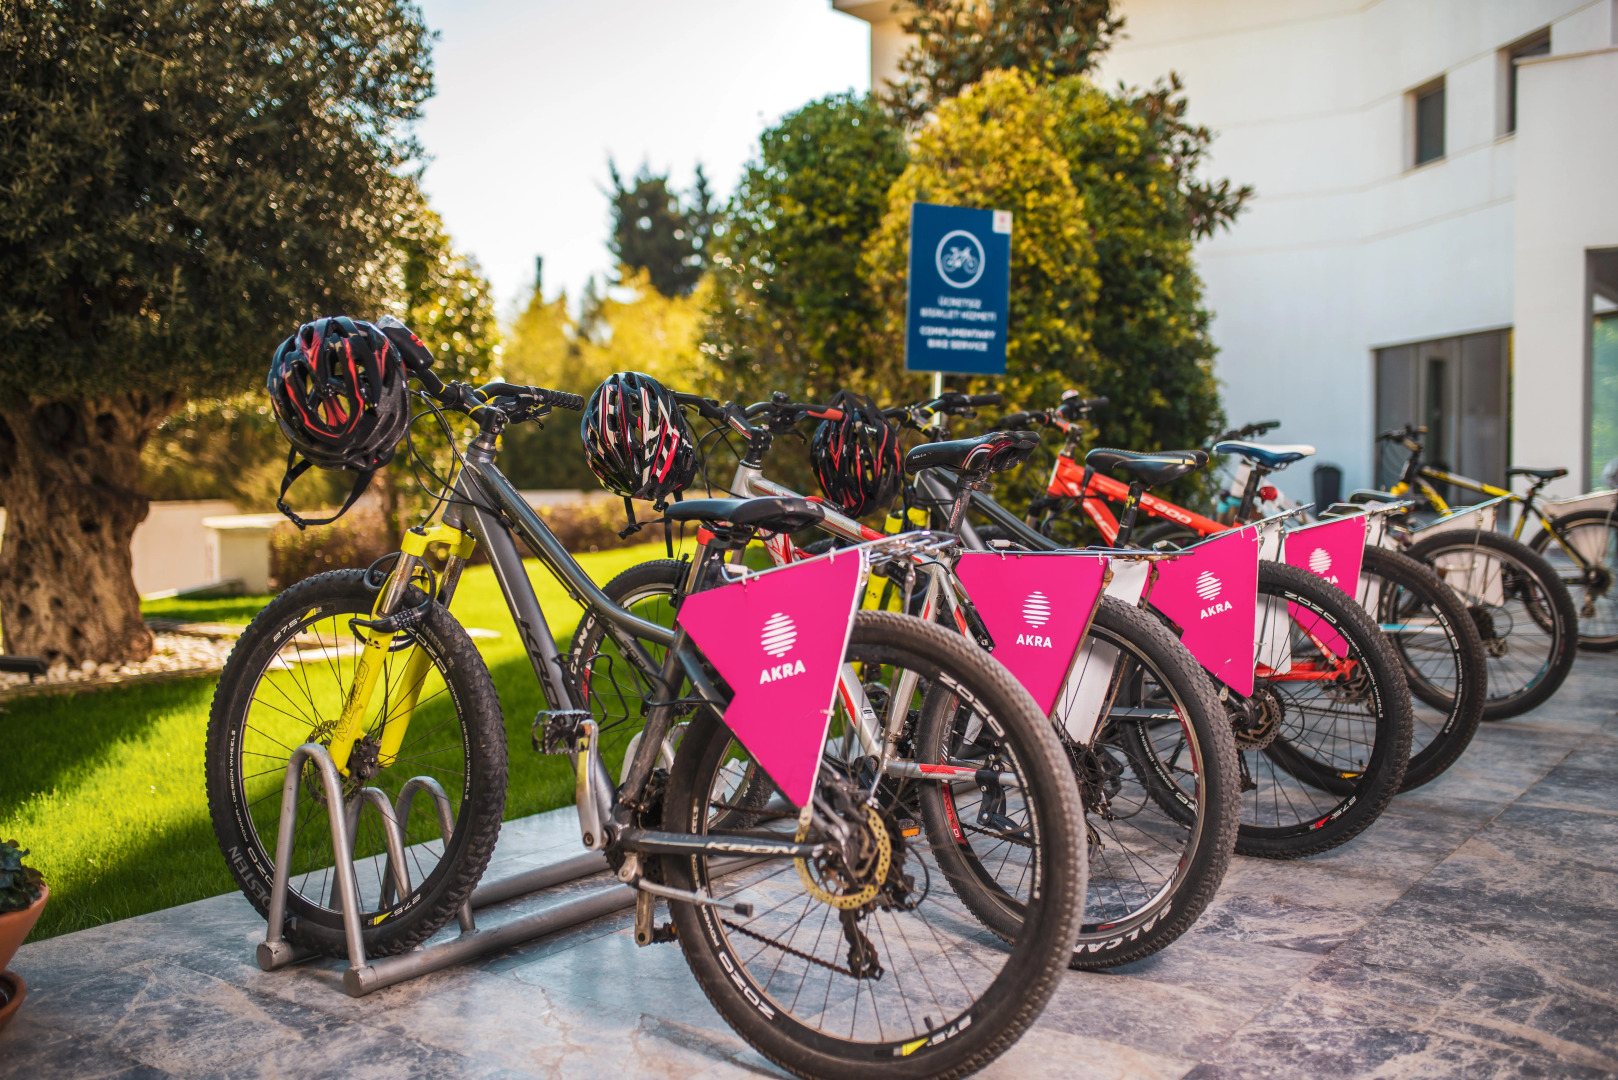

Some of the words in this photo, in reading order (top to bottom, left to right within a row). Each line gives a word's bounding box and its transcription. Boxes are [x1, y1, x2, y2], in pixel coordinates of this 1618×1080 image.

[1200, 601, 1233, 620] AKRA
[1016, 633, 1053, 649] AKRA
[520, 619, 562, 711] KRO
[760, 659, 806, 685] AKRA
[1338, 626, 1360, 652] POWER
[1374, 686, 1384, 718] WHEELS
[447, 678, 463, 714] POWER
[229, 729, 237, 768] WHEELS
[705, 841, 801, 855] KRON
